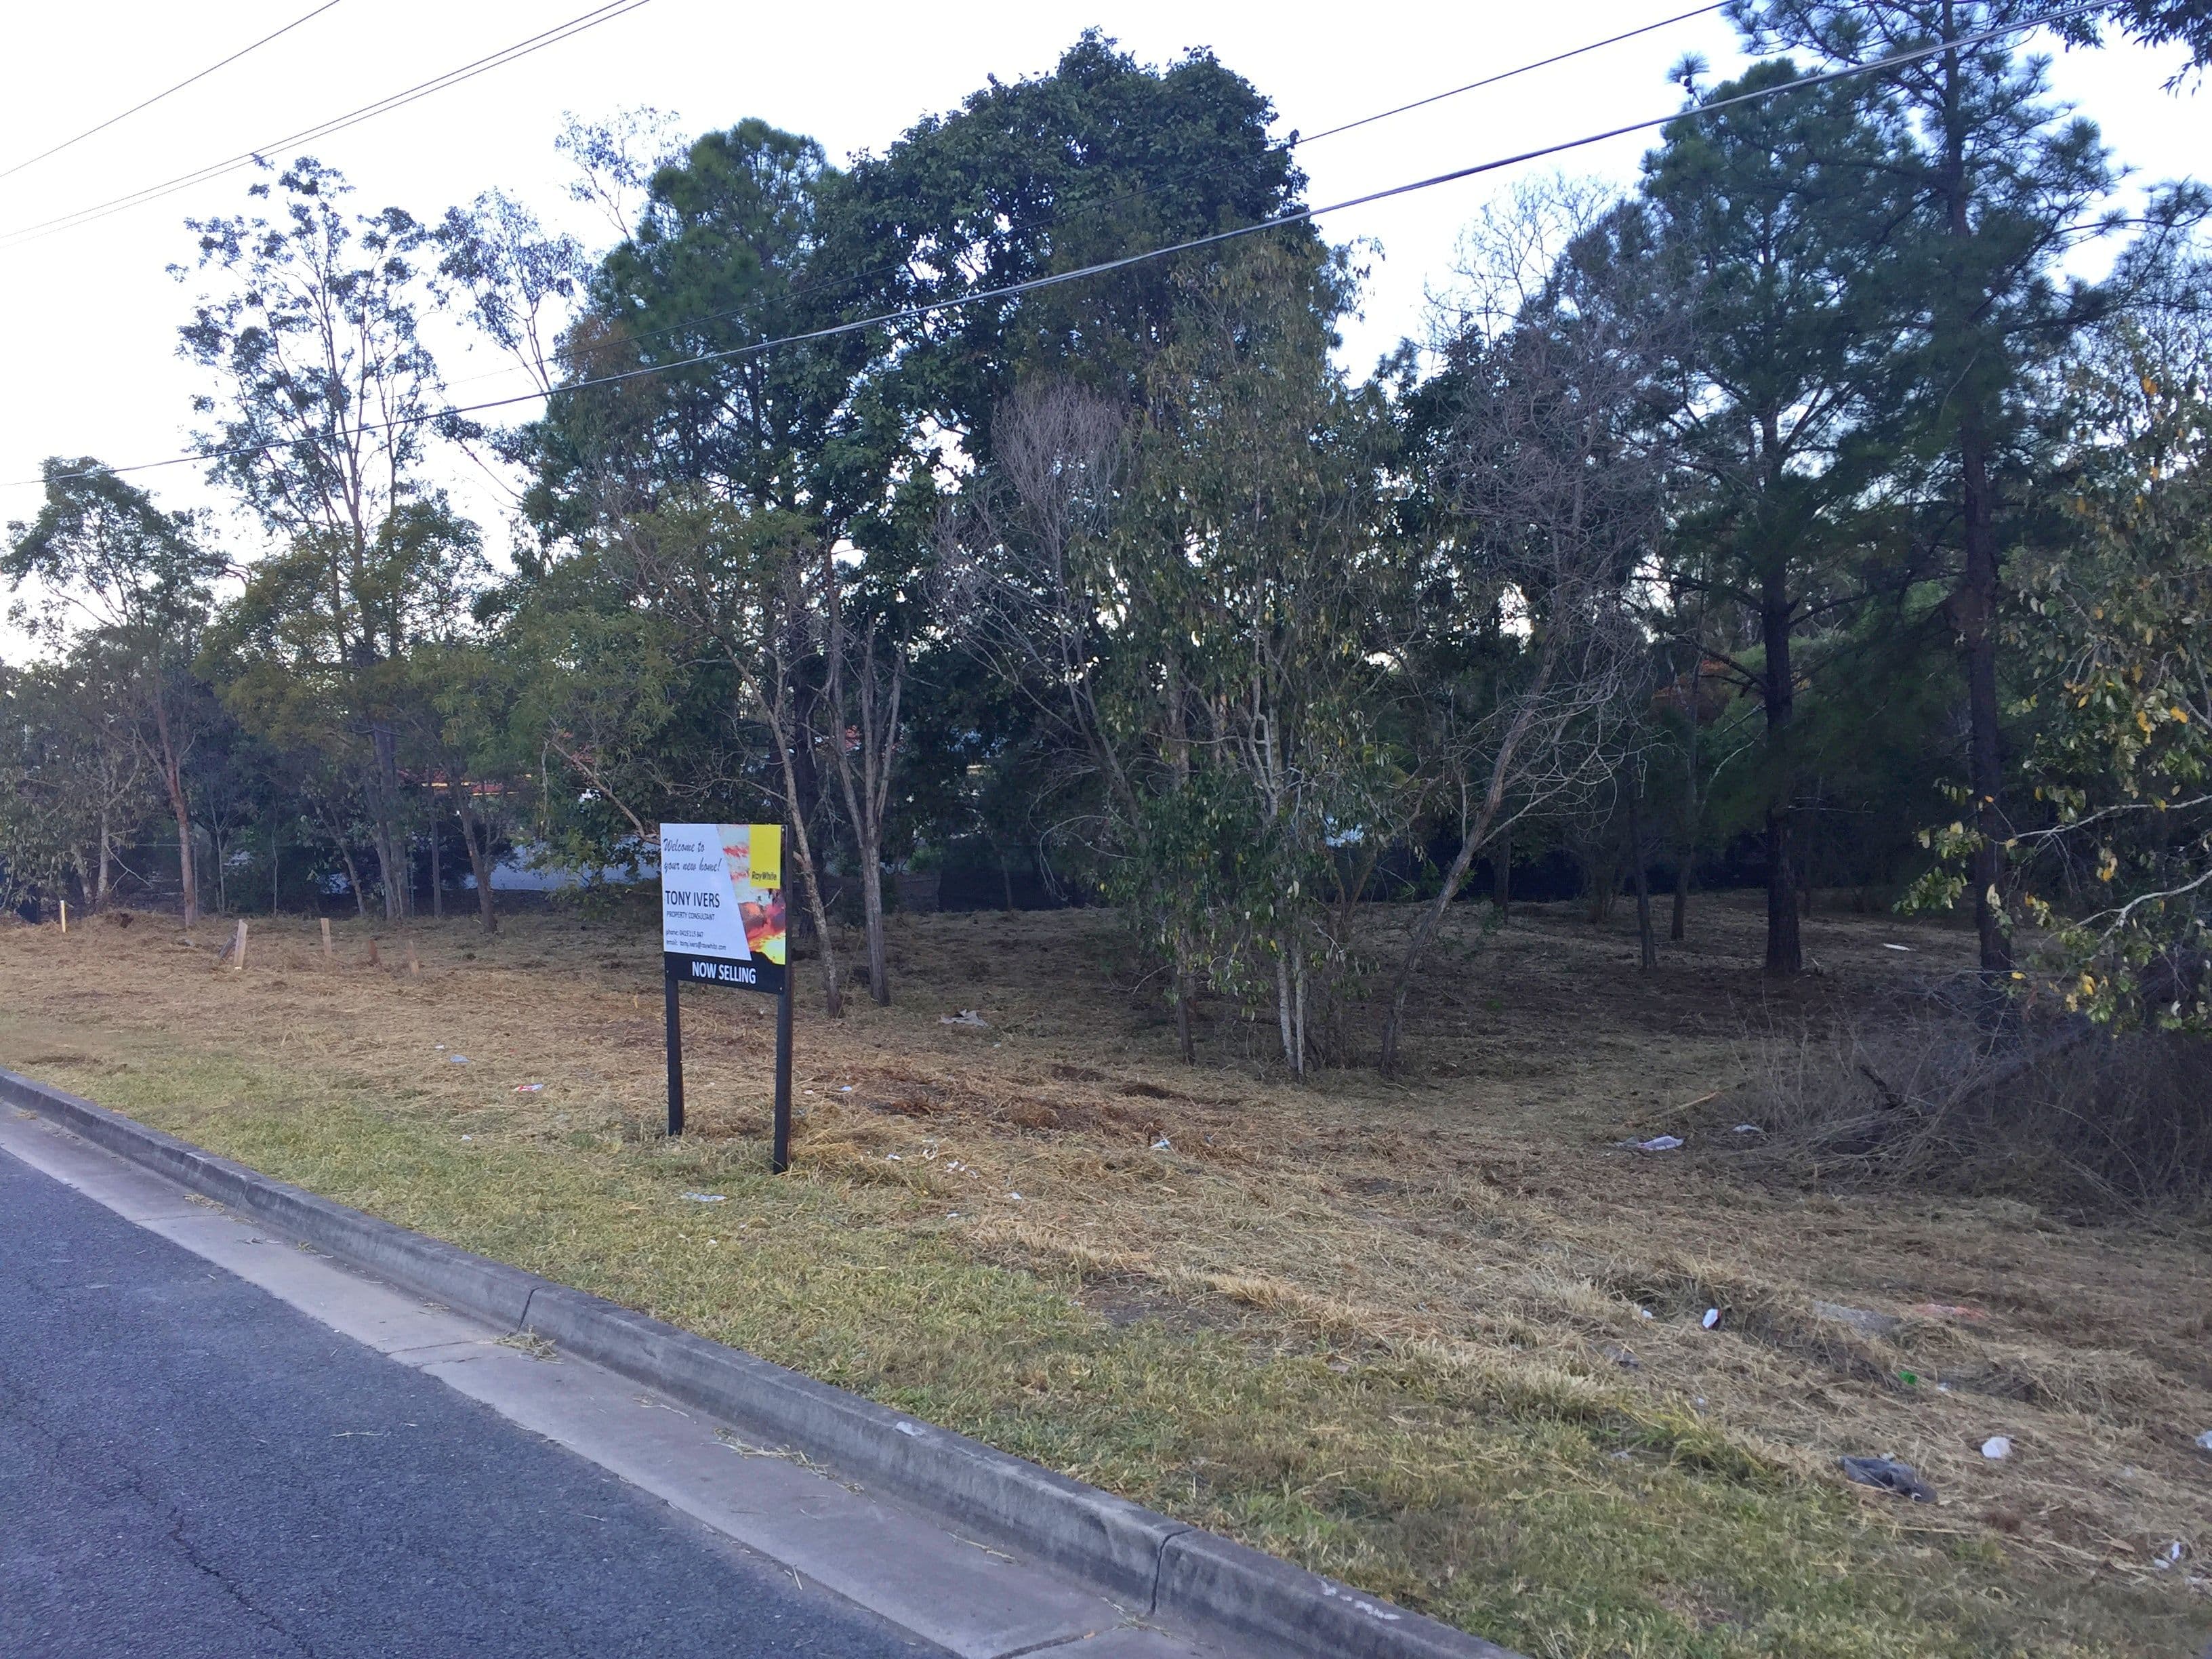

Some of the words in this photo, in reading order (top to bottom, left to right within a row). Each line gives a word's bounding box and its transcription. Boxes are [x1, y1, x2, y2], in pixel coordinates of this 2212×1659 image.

[663, 838, 695, 853] Welcome
[697, 841, 705, 853] to
[664, 861, 680, 874] your
[699, 857, 722, 872] home!
[665, 890, 691, 906] TONY
[693, 891, 720, 908] IVERS
[666, 910, 687, 918] PROPERTY
[689, 912, 715, 921] CONSULTANT
[692, 961, 716, 979] NOW
[718, 964, 756, 984] SELLING
